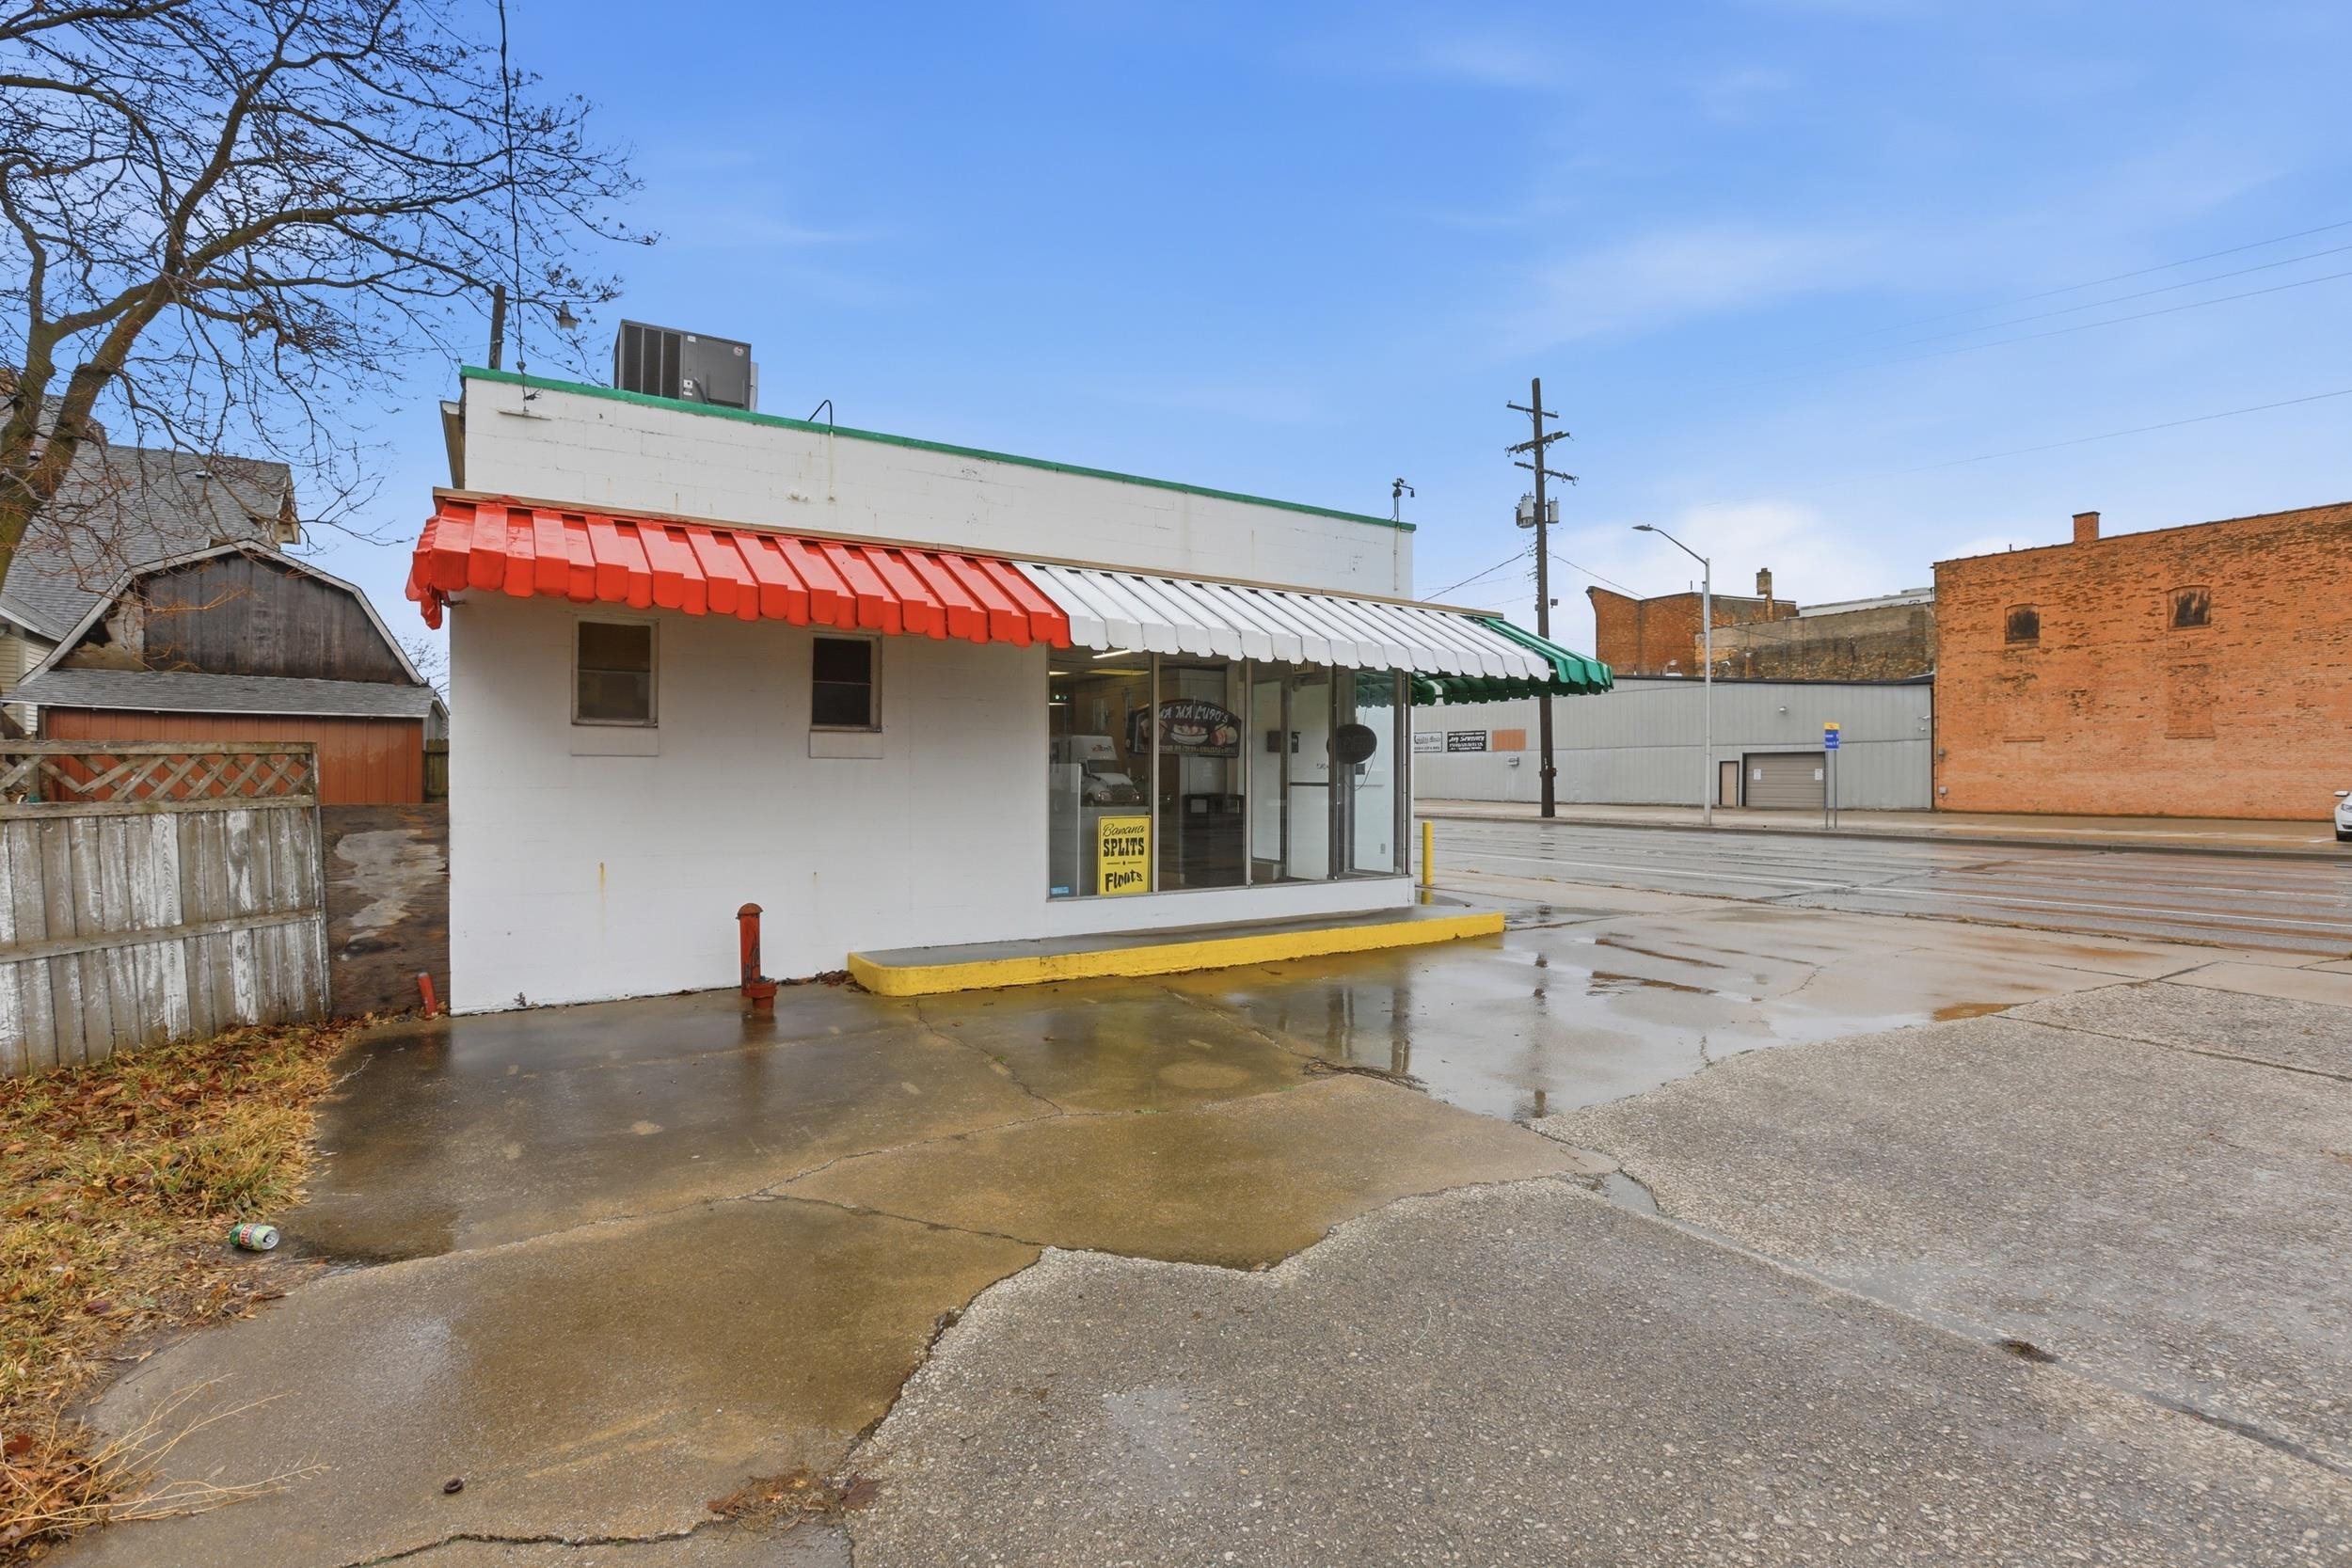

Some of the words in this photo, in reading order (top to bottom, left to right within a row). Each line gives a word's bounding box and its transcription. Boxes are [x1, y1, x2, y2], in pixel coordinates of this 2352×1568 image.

[1103, 822, 1145, 837] Banana
[1103, 836, 1145, 857] SPLITS
[1104, 868, 1143, 893] Floats
